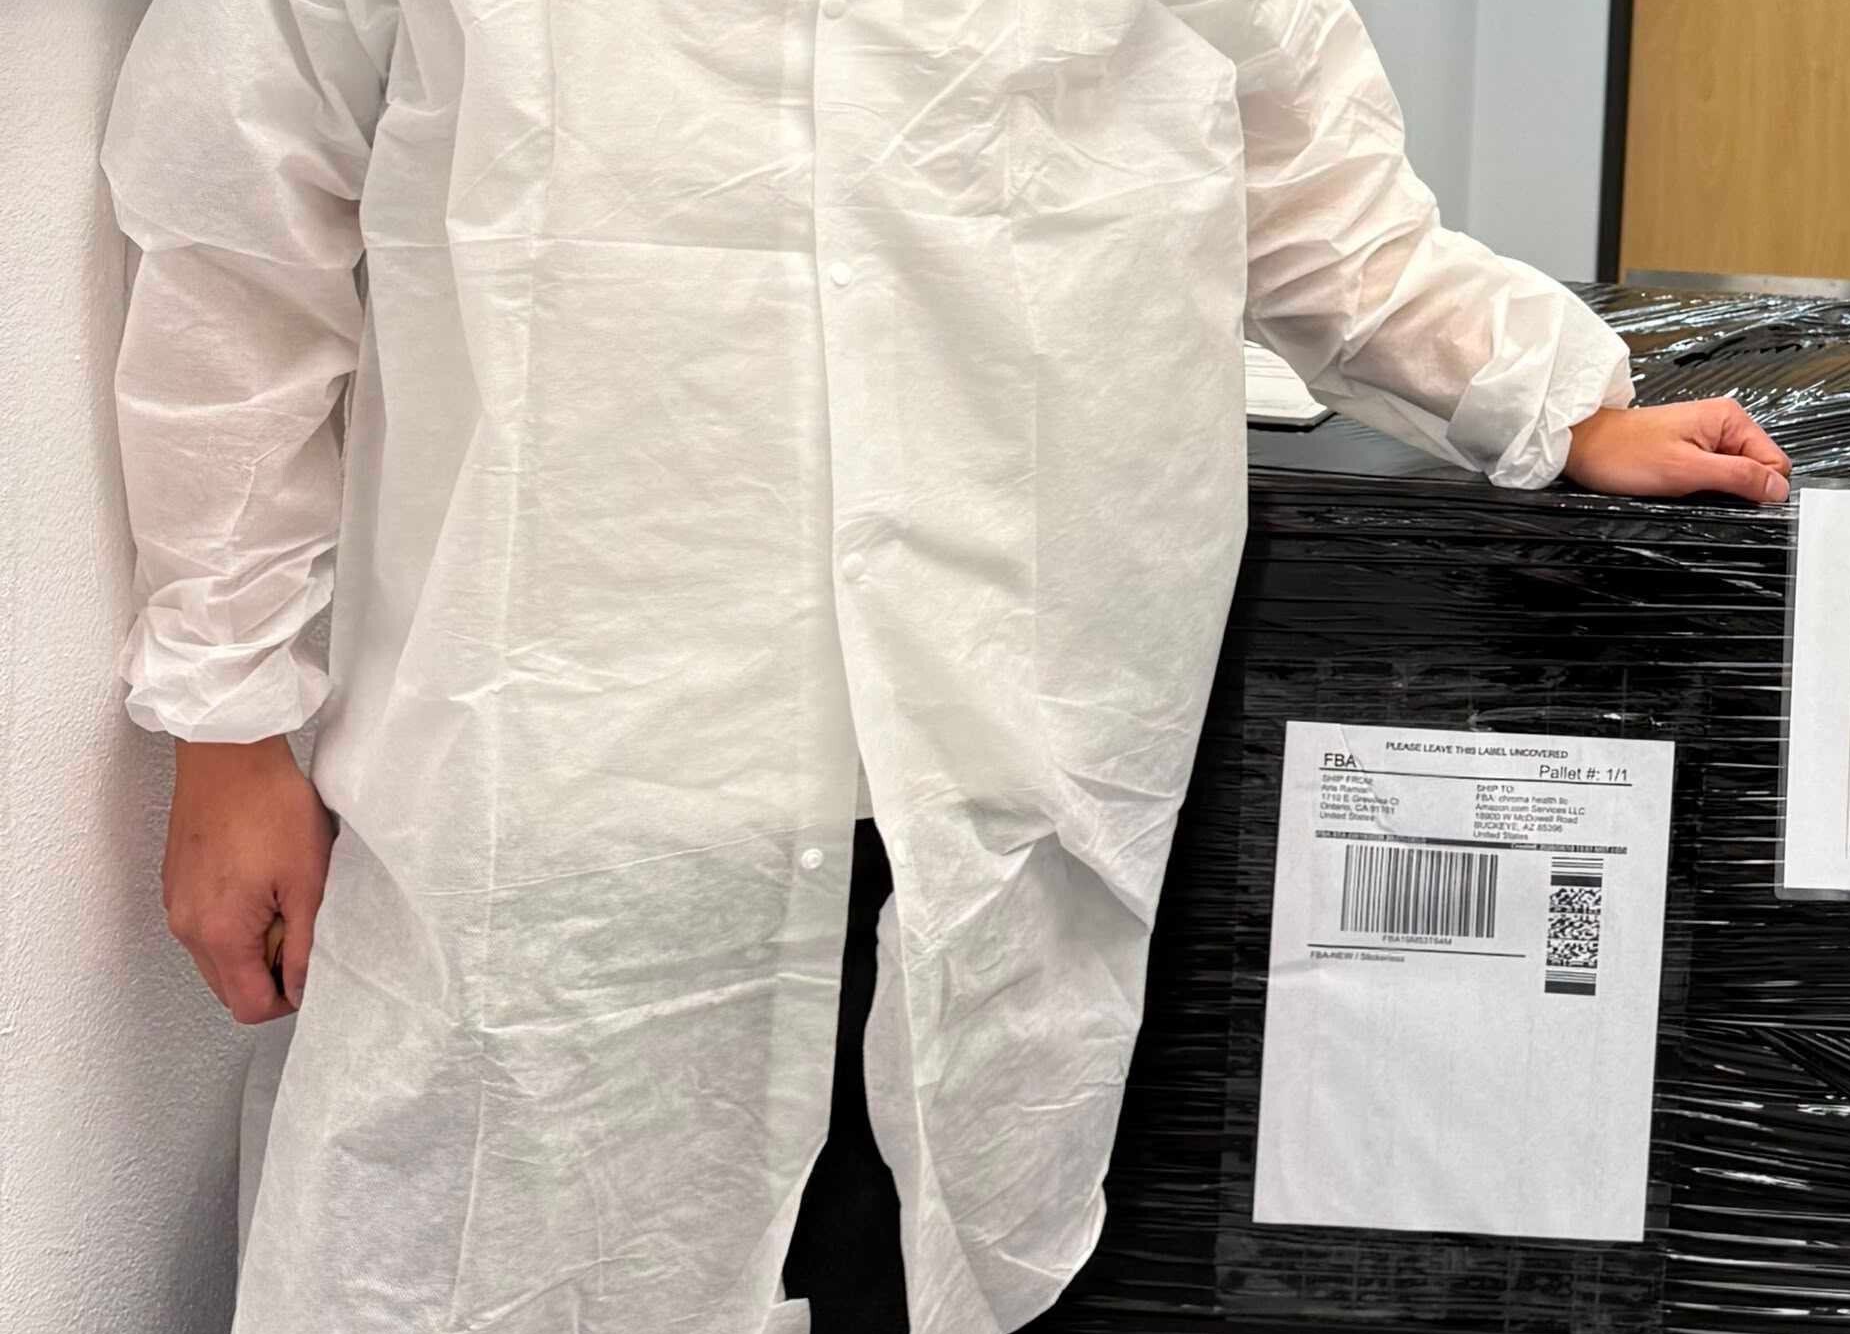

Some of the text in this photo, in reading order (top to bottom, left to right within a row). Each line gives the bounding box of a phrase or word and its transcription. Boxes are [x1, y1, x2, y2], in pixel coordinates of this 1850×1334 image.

[1386, 741, 1569, 759] PLEASE LEAVE THIS LABEL UNCOVERED
[1539, 764, 1581, 780] Pallet
[1586, 768, 1601, 781] #:
[1606, 768, 1628, 781] 1/1
[1477, 784, 1498, 792] SHIP
[1531, 804, 1566, 814] Services
[1568, 806, 1585, 815] LLC
[1556, 815, 1578, 824] Road
[1473, 831, 1529, 840] United States
